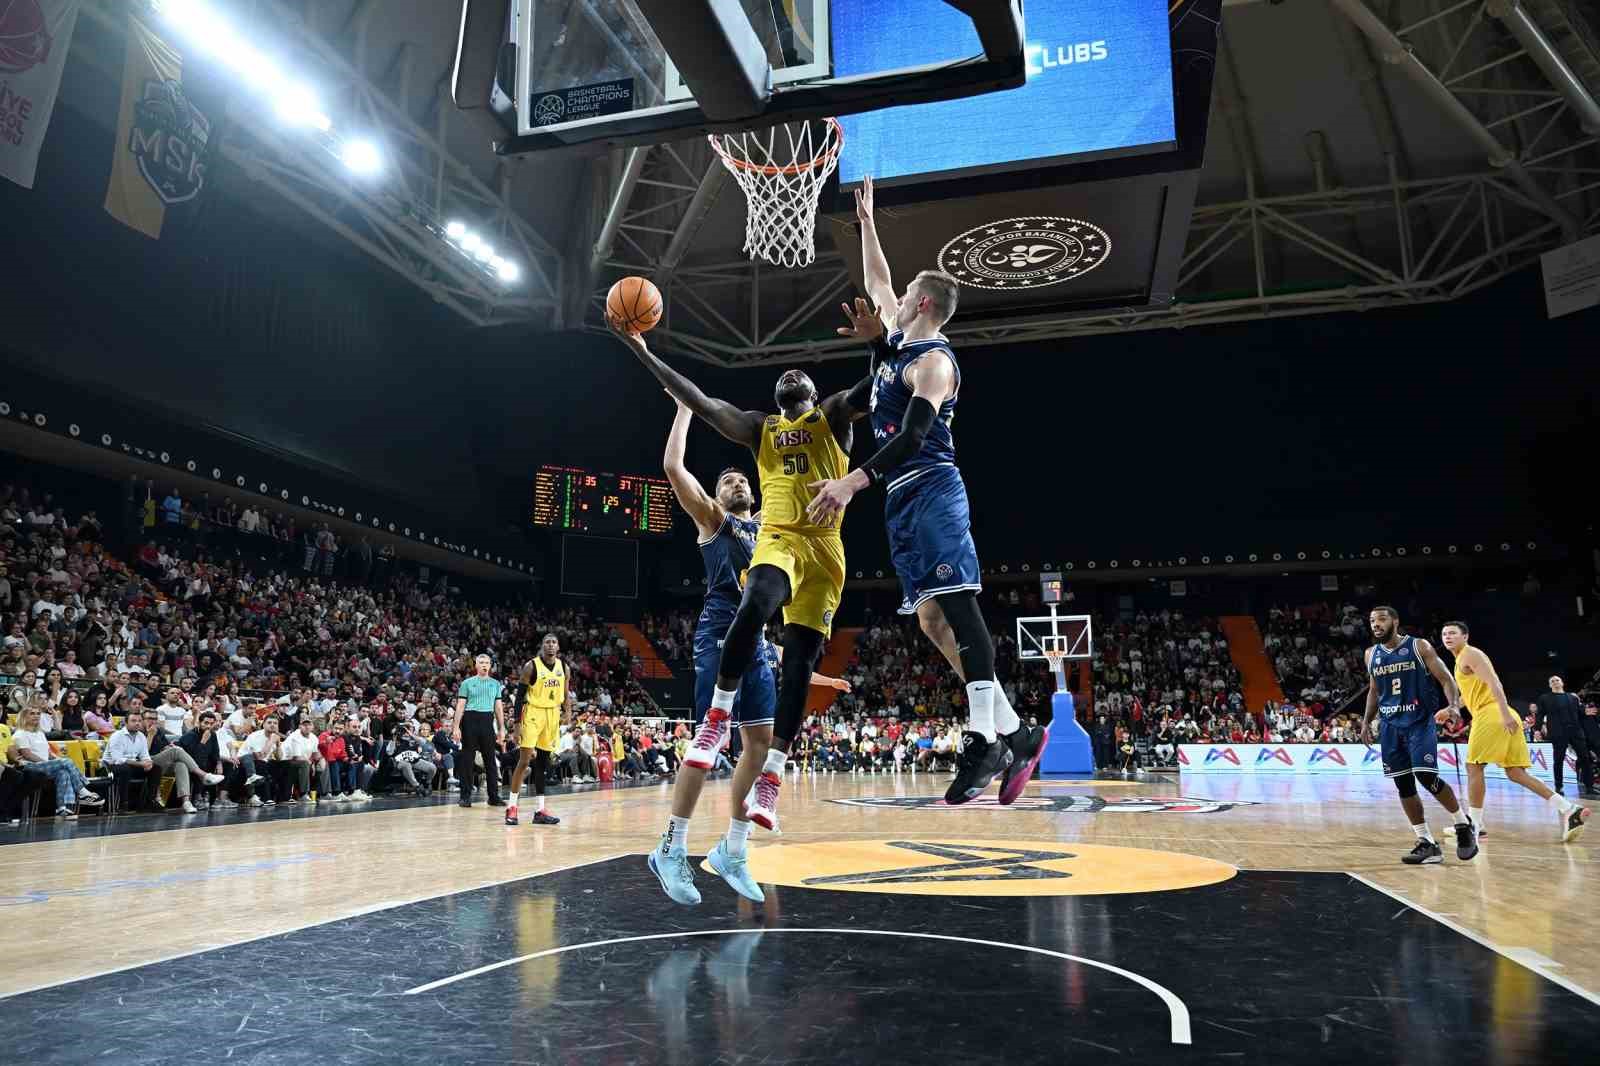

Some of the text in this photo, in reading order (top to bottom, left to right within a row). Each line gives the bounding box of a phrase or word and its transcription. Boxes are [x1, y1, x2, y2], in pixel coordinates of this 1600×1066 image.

[568, 84, 623, 98] BASKETBALL
[568, 89, 630, 106] CHAMPIONS
[568, 102, 600, 114] LEAGUE
[130, 128, 206, 182] MSK
[774, 429, 813, 448] MSK
[783, 452, 809, 475] 50
[585, 475, 597, 487] 35
[619, 479, 631, 490] 37
[1373, 661, 1416, 677] KARDITSA
[1391, 678, 1401, 695] 2
